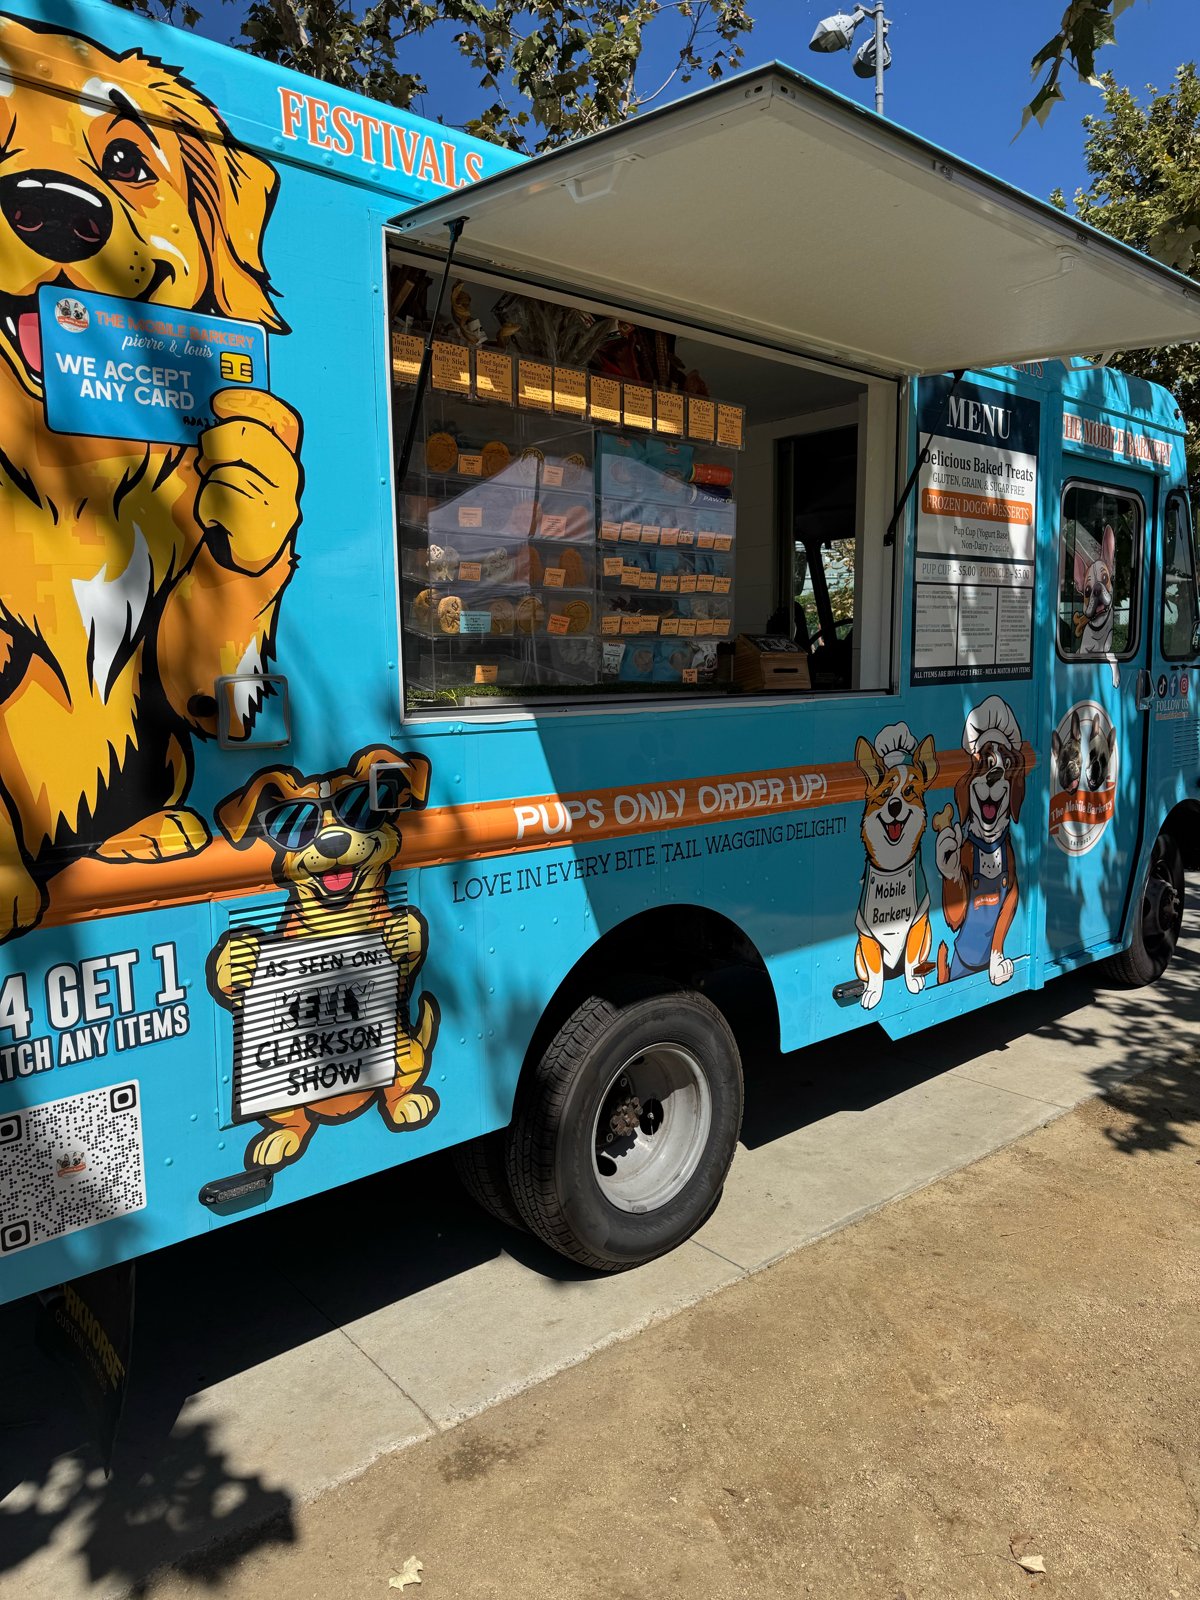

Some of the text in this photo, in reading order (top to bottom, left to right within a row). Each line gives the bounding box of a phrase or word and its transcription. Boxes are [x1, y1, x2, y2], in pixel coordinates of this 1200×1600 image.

[277, 86, 483, 190] FESTIVALS
[95, 311, 124, 328] THE
[128, 316, 186, 338] MOBILE
[189, 328, 254, 349] BARKERY
[122, 334, 213, 358] pierre & louis
[55, 352, 191, 390] WE ACCEPT
[452, 356, 467, 366] Stick
[80, 379, 194, 410] ANY CARD
[946, 395, 1012, 439] MENU
[1063, 413, 1173, 466] HE MOBILE BARKERY
[923, 450, 1034, 482] Delicious Baked Treats
[932, 472, 961, 487] GLUTEN,
[990, 481, 1009, 494] SUGAR
[1011, 485, 1025, 496] FREE
[926, 494, 1030, 520] FROZEN DOGGY DESSERTS
[965, 527, 975, 539] Cup
[922, 563, 936, 575] PUP
[937, 564, 951, 576] CUP
[958, 565, 976, 577] $5.00
[1014, 568, 1030, 580] $5.00
[513, 773, 829, 840] PUPS ONLY ORDER UP!
[1050, 807, 1064, 821] The
[452, 871, 512, 904] LOVE
[516, 866, 543, 891] IN
[546, 853, 612, 887] EVERY
[660, 840, 702, 864] TAIL
[704, 825, 784, 855] WAGGING
[785, 816, 847, 842] DELIGHT!
[875, 881, 906, 900] Mobile
[872, 906, 912, 924] Barkery
[264, 950, 384, 978] AS SEEN ON:
[0, 944, 185, 1038] 4 GET 1
[272, 980, 376, 1033] KELLY
[60, 1022, 108, 1066] ANY
[116, 1004, 188, 1050] ITEMS
[255, 1023, 383, 1069] CLARKSON
[287, 1058, 363, 1096] SHOW
